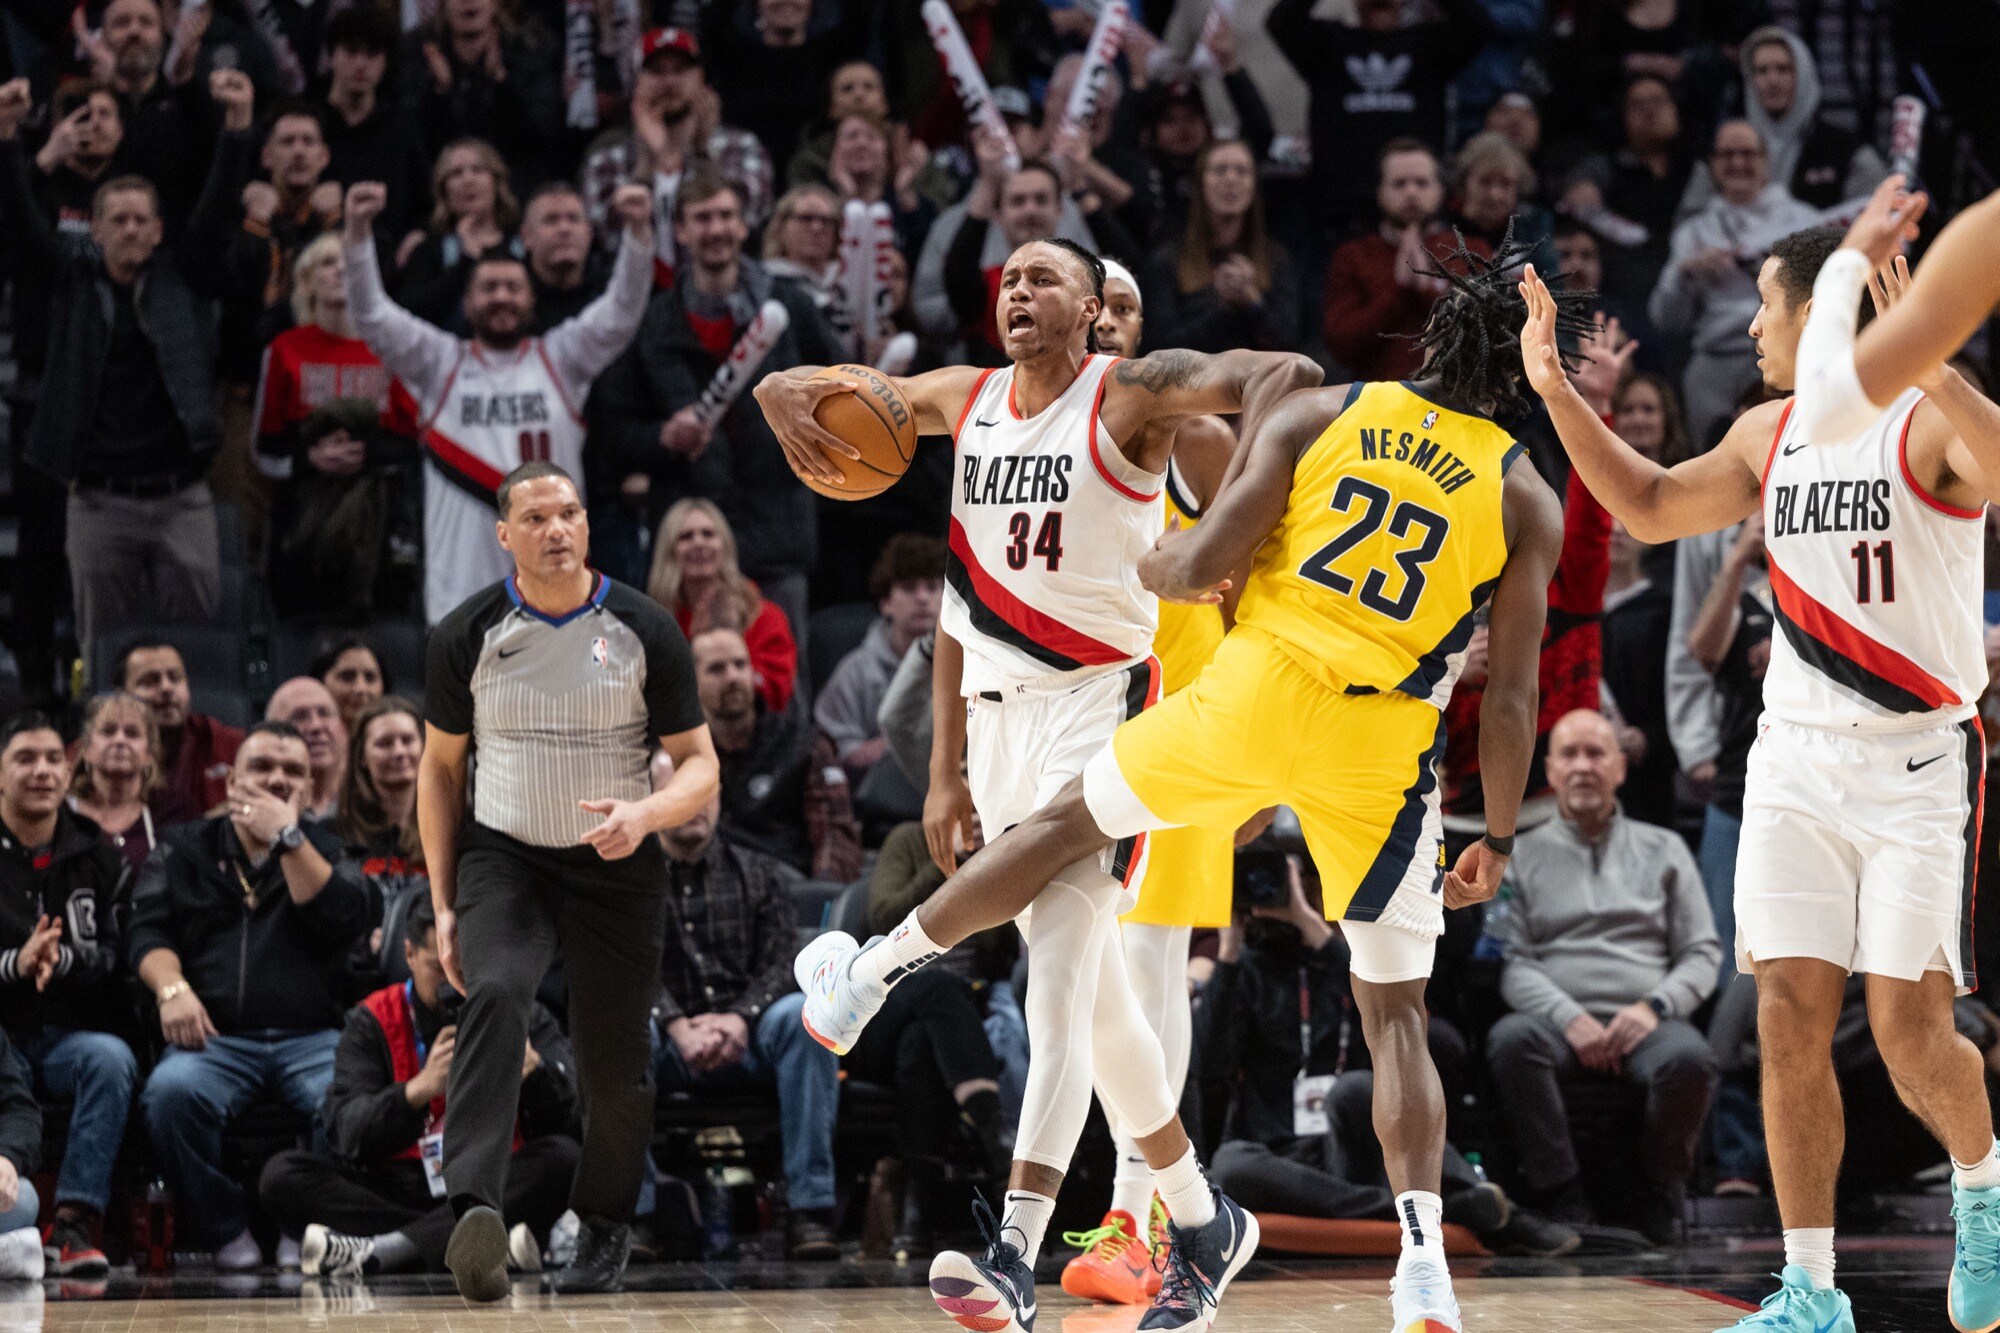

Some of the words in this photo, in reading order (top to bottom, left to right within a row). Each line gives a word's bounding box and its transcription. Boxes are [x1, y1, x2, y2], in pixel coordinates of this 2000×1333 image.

[963, 454, 1073, 505] BLAZERS
[1360, 428, 1476, 495] NESMITH
[1773, 479, 1891, 538] BLAZERS
[1006, 511, 1064, 572] 34
[1297, 475, 1450, 623] 23
[1851, 540, 1896, 605] 11
